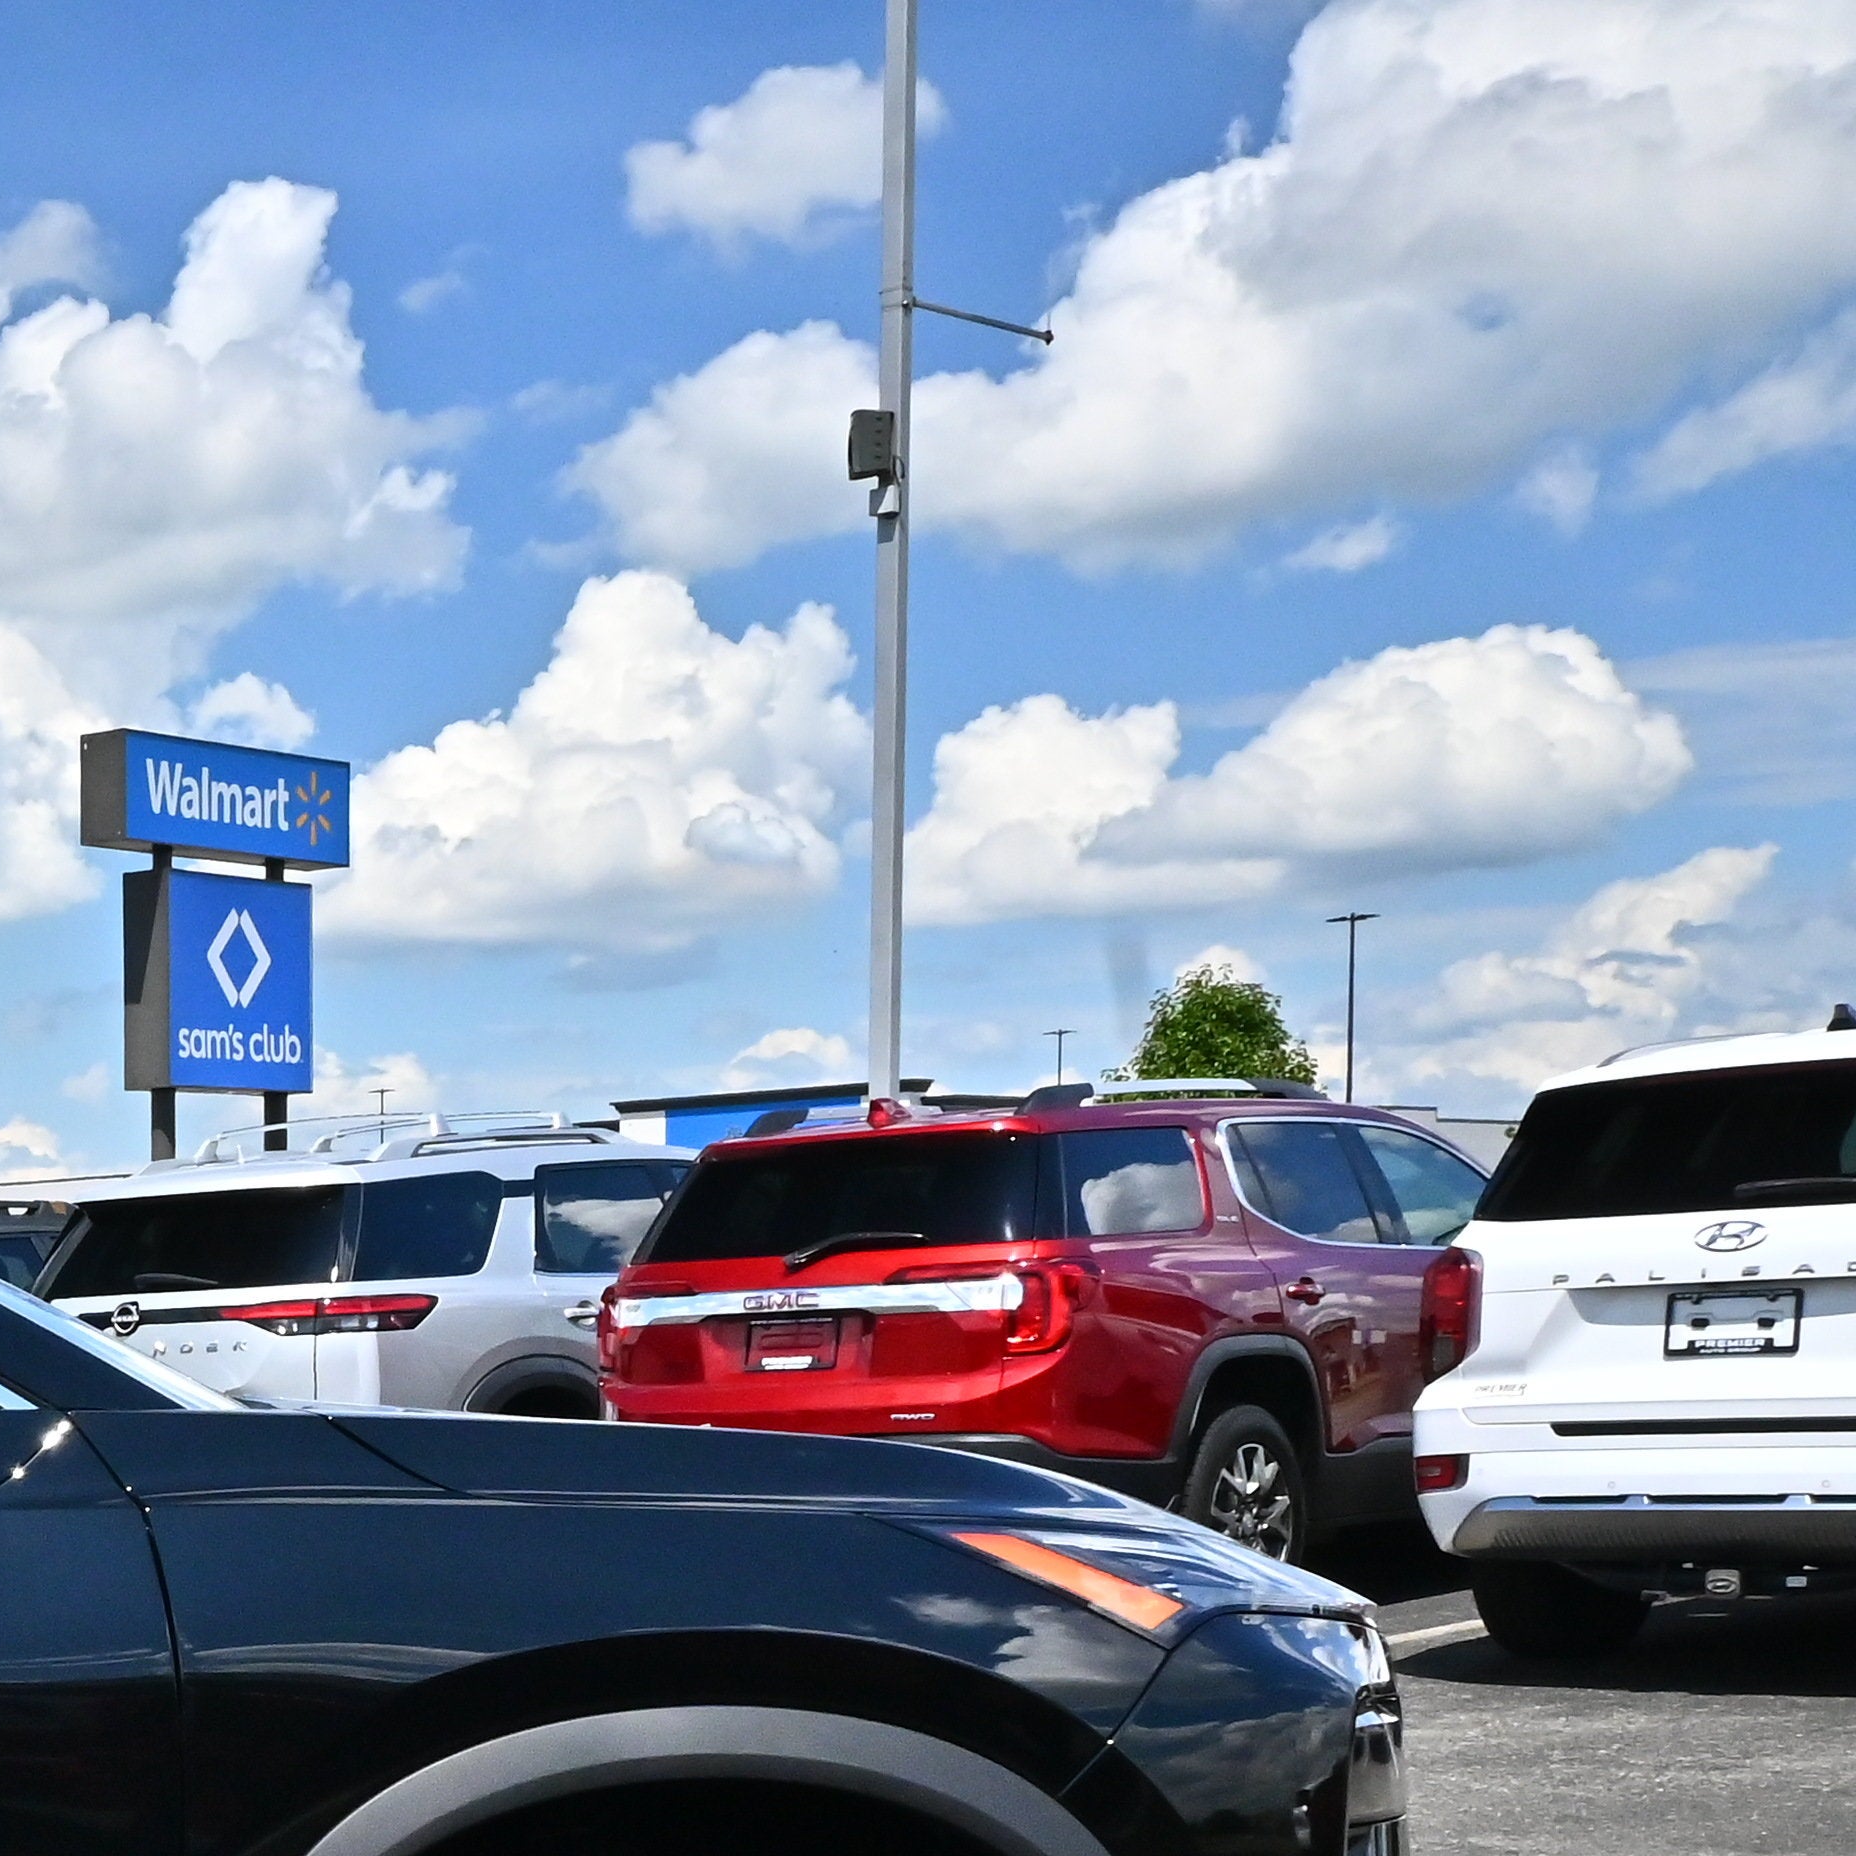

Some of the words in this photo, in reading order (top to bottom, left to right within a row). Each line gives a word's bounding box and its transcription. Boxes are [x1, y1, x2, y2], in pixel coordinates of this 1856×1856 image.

[145, 757, 291, 832] Walmart
[178, 1022, 245, 1061] sam's
[249, 1023, 302, 1064] club
[743, 1292, 820, 1311] GMC
[1694, 1338, 1766, 1348] PREMIER
